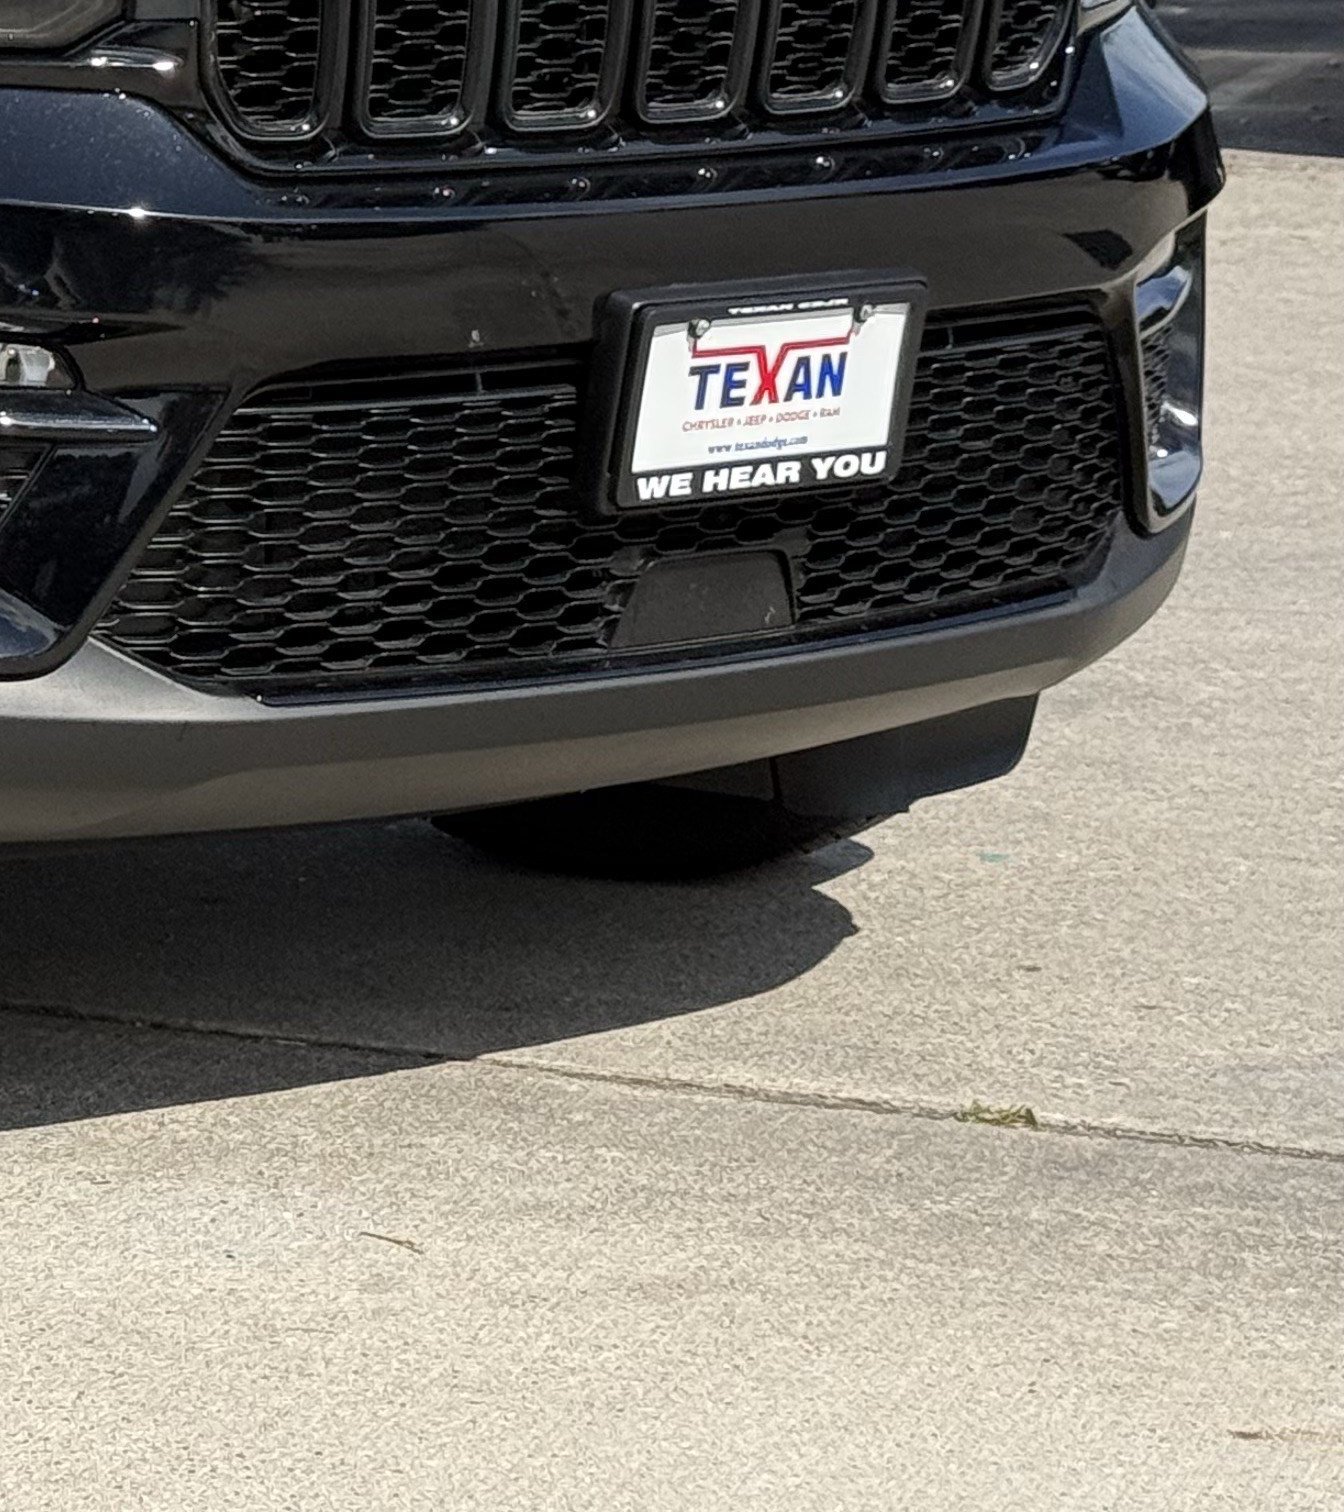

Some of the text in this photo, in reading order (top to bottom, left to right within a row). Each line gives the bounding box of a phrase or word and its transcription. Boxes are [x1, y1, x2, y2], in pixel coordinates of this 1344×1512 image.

[687, 340, 849, 411] TEXAN
[637, 450, 888, 501] WE HEAR YOU
